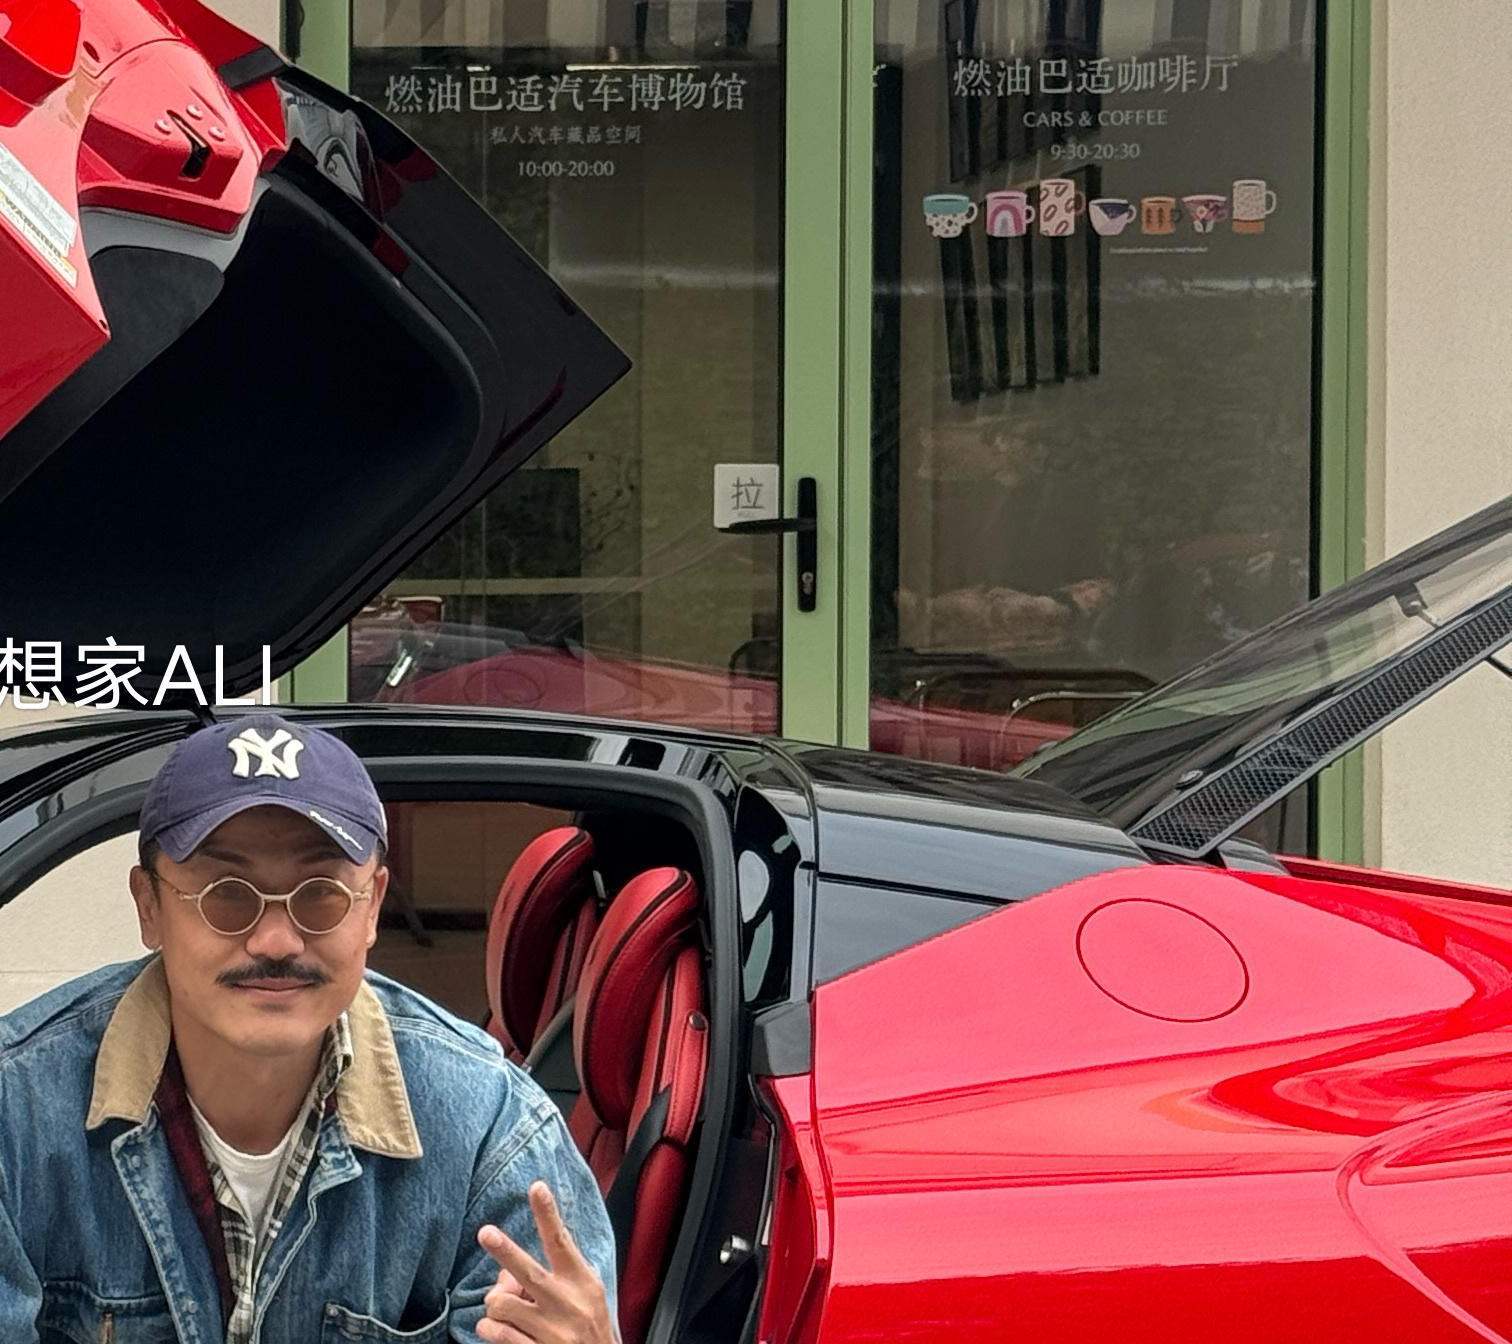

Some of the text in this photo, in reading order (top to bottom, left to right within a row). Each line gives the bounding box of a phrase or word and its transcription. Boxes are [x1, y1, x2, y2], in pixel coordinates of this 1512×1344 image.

[953, 55, 1239, 97] 燃油巴适咖啡厅
[385, 72, 747, 113] 燃油巴适汽车博物馆
[1023, 109, 1169, 128] CARS & COFFEE
[1051, 143, 1142, 160] 9:30-20:30
[518, 160, 615, 177] 10:00-20:00
[731, 476, 766, 511] 拉
